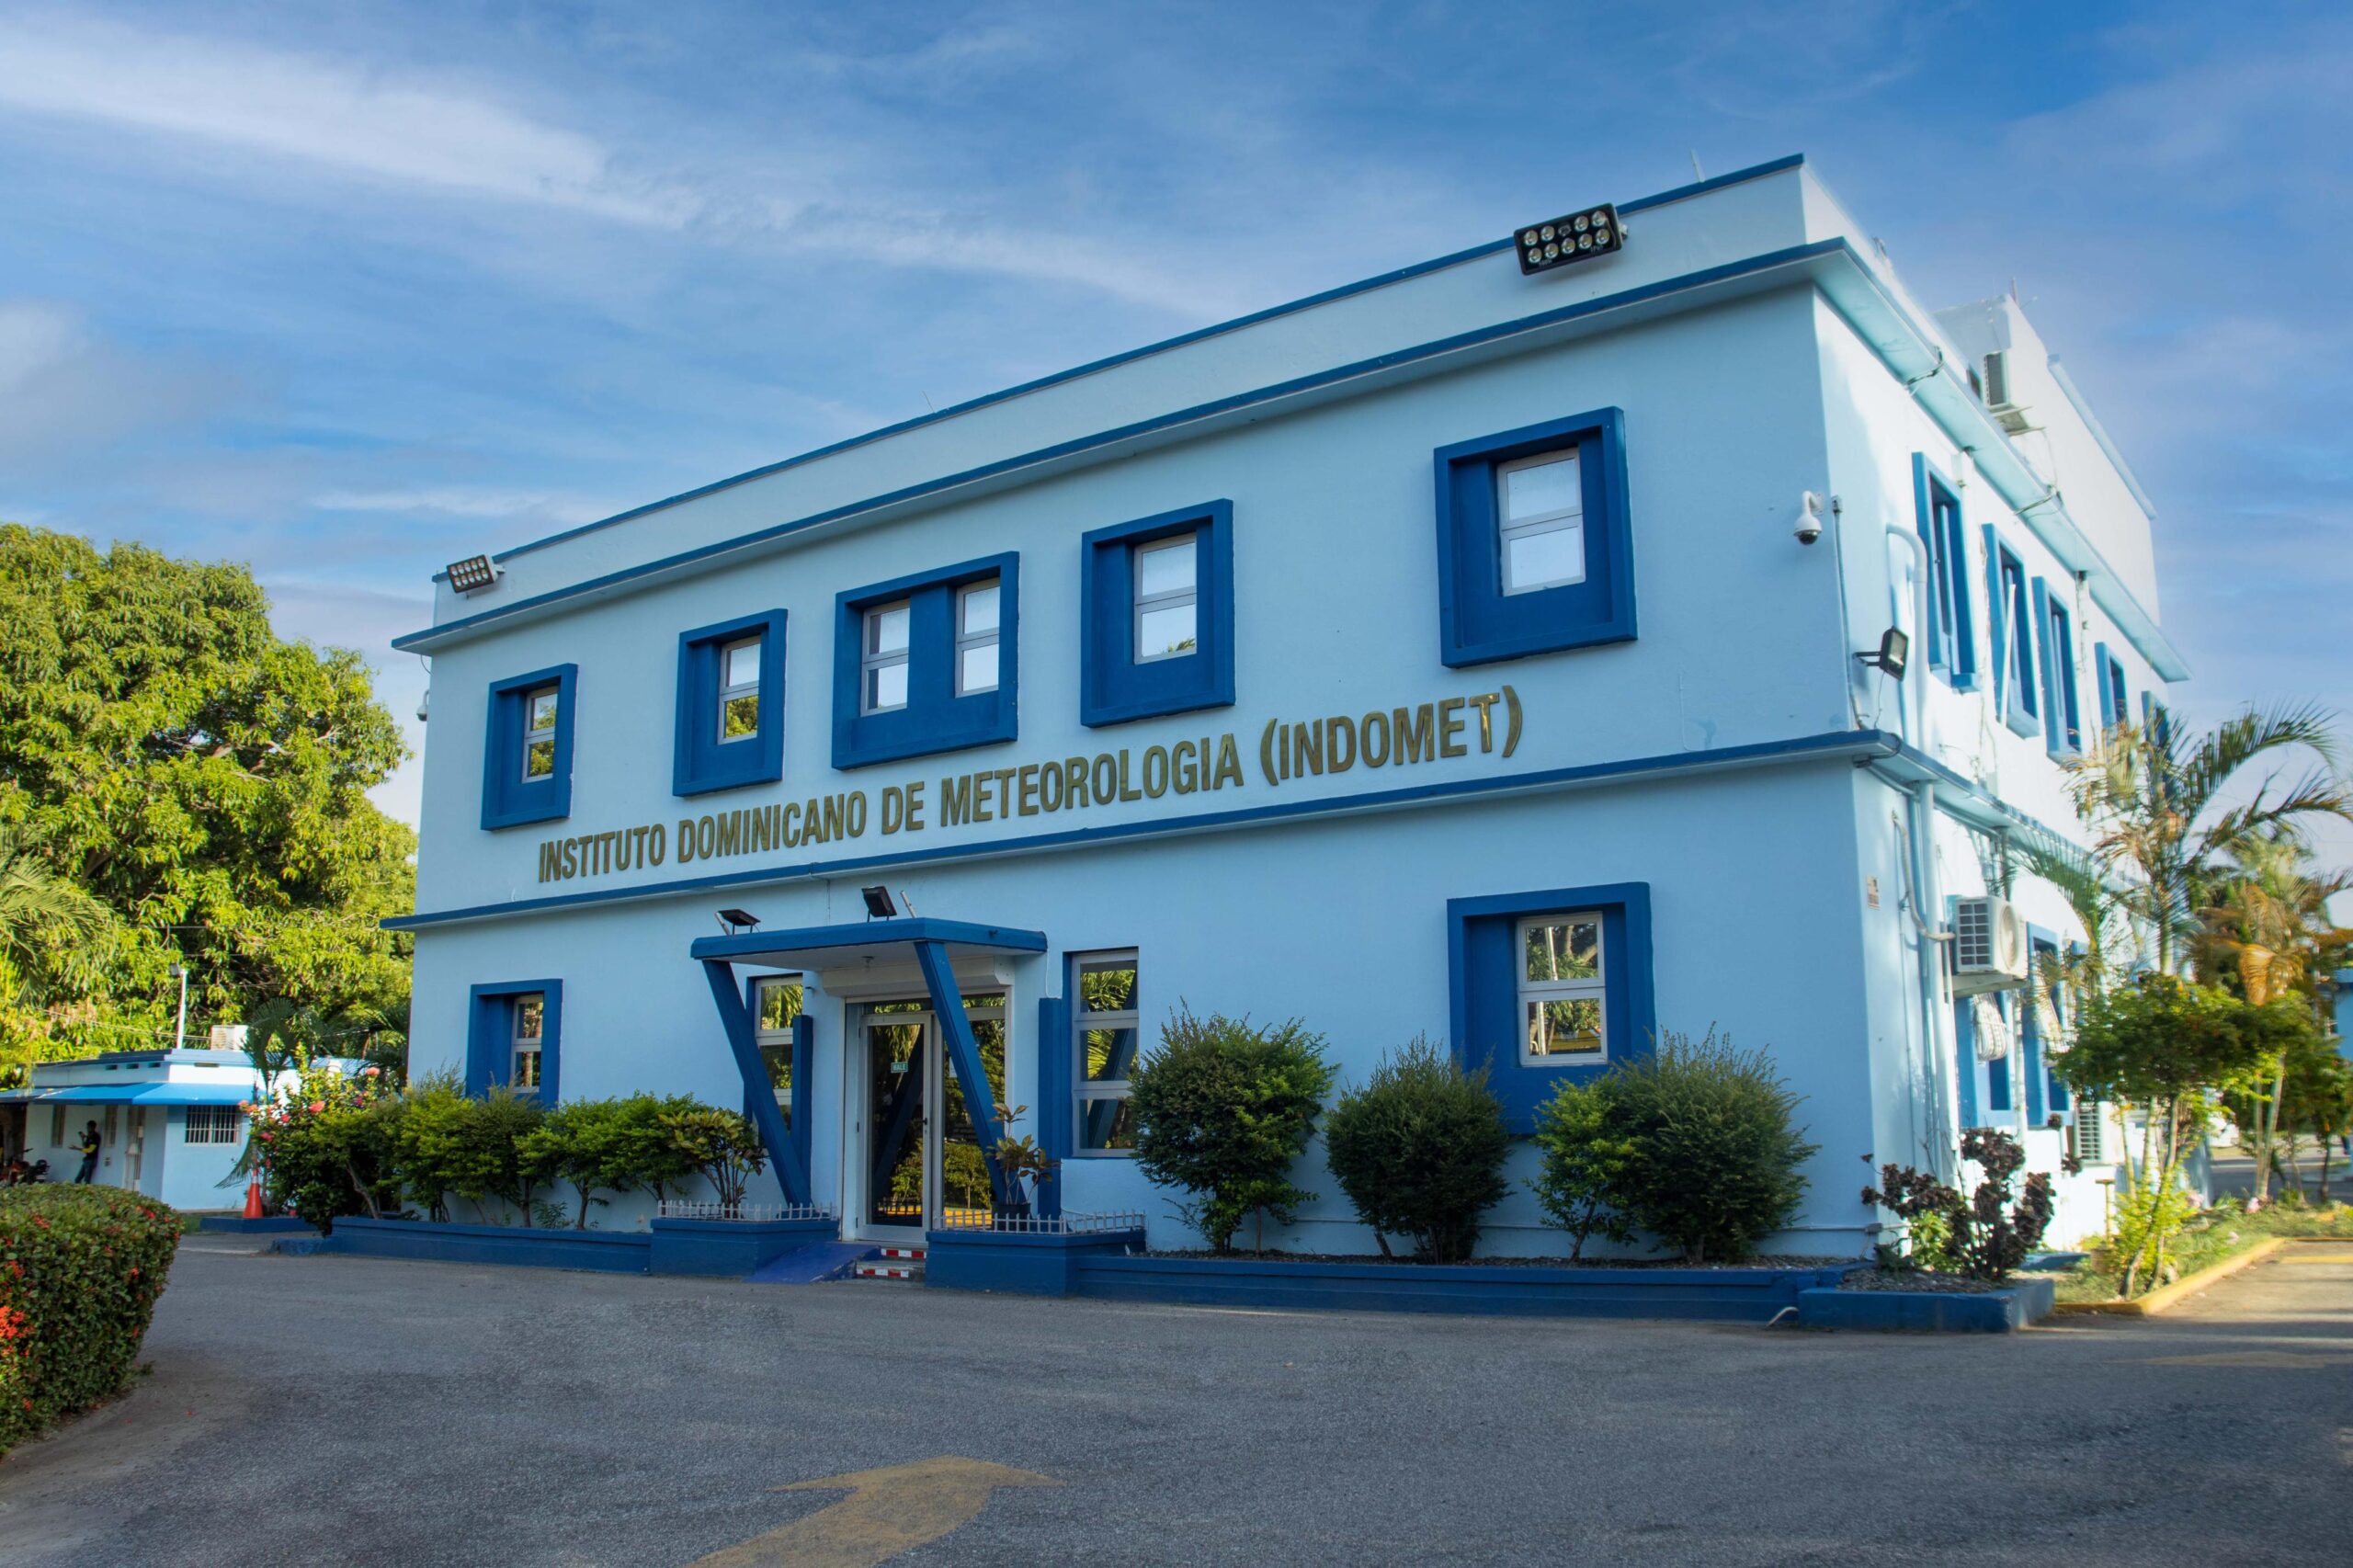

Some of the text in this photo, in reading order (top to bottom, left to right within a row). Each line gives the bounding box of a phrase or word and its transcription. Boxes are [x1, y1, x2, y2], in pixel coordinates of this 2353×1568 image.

[539, 685, 1523, 883] INSTITUTO DOMINICANO DE METEOROLOGIA (INDOMET)
